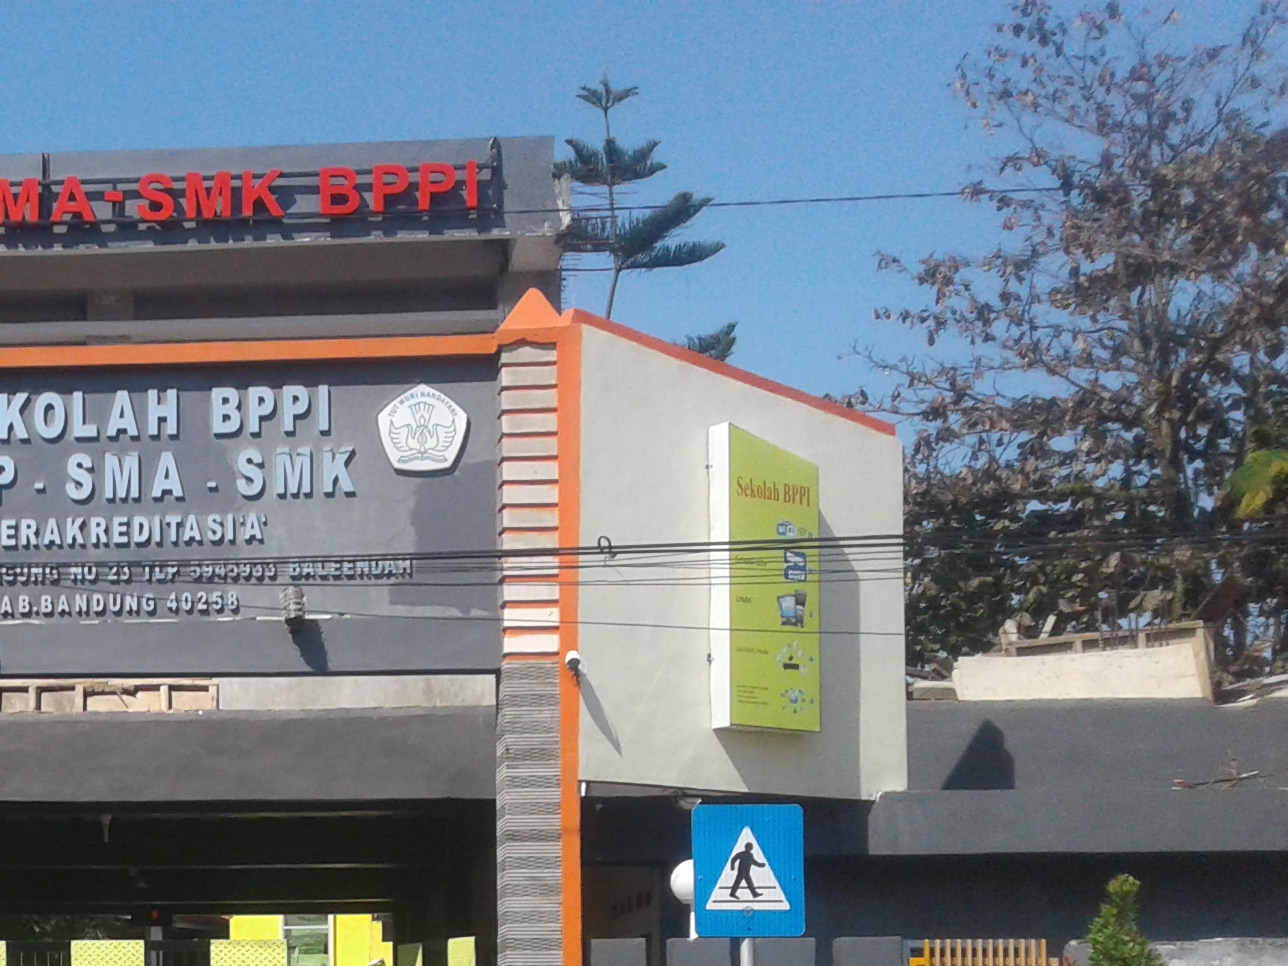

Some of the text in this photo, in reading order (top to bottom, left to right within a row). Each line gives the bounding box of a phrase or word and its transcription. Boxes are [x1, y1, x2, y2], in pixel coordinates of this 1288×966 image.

[318, 160, 478, 216] BPPI
[211, 385, 329, 435] BPPI
[388, 405, 400, 418] TUT
[399, 392, 419, 406] WURI
[65, 451, 184, 500] SMA
[236, 446, 356, 498] SMK
[737, 476, 811, 507] Sekolah BPPI
[107, 562, 130, 580] 23
[166, 591, 238, 611] 40258
